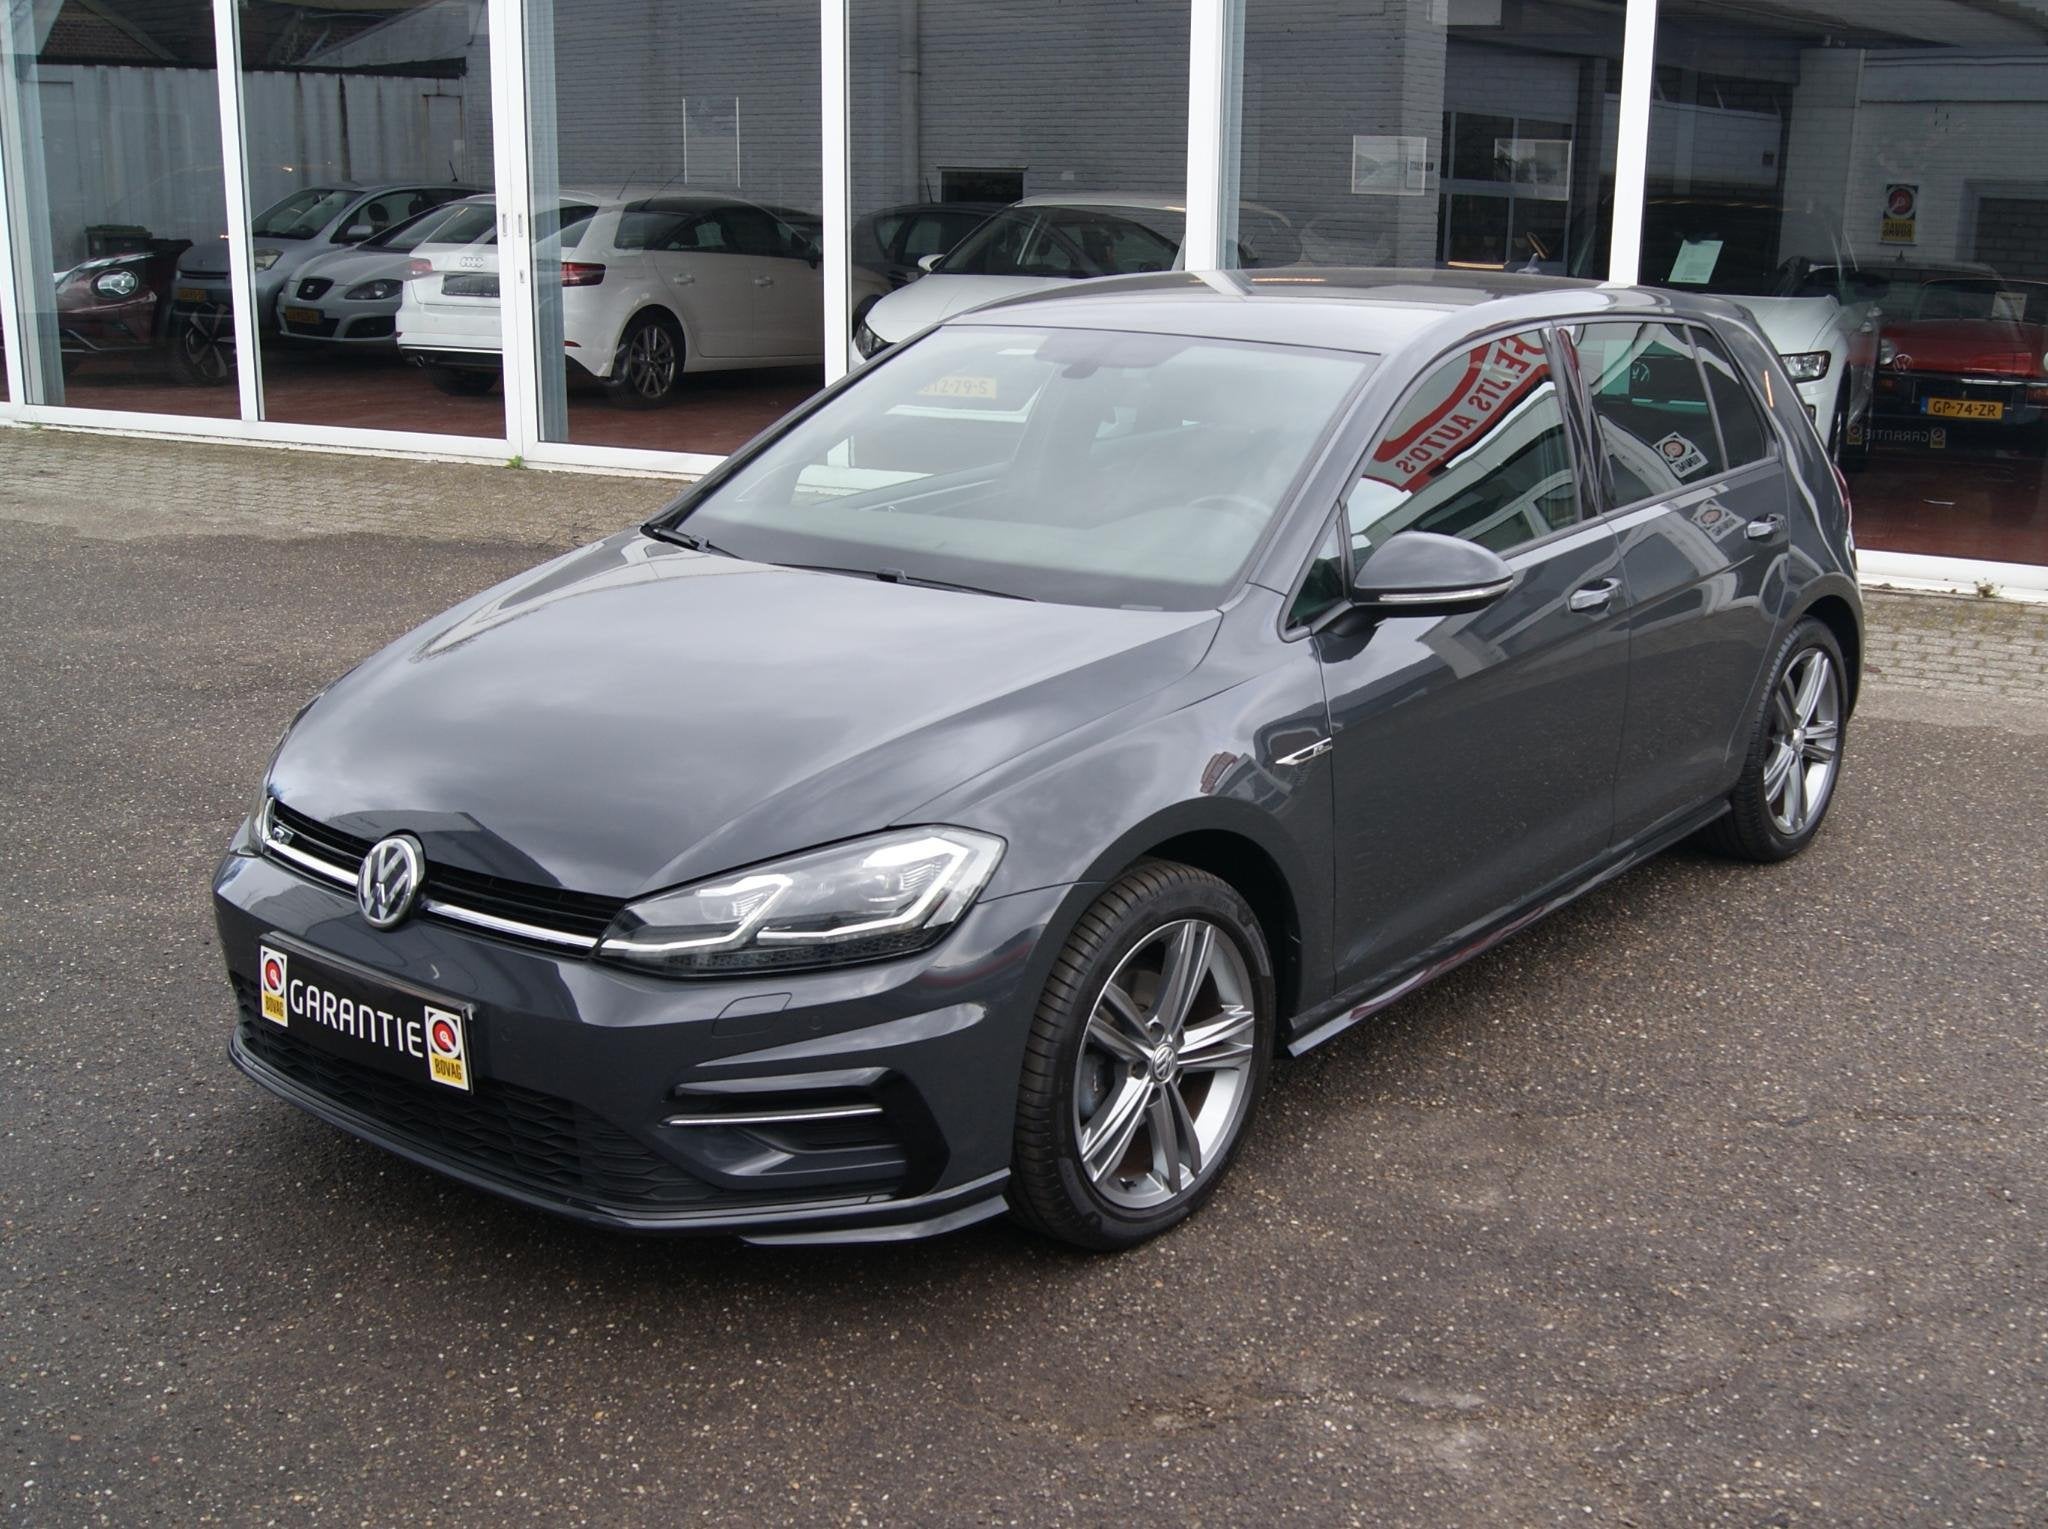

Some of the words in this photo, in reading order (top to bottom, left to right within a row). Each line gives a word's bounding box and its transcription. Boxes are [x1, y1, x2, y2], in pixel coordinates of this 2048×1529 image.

[1932, 400, 1997, 417] GP-74-ZR
[265, 995, 285, 1017] BOVAG
[289, 978, 424, 1059] GARANTIE
[434, 1059, 462, 1081] BOVAG
